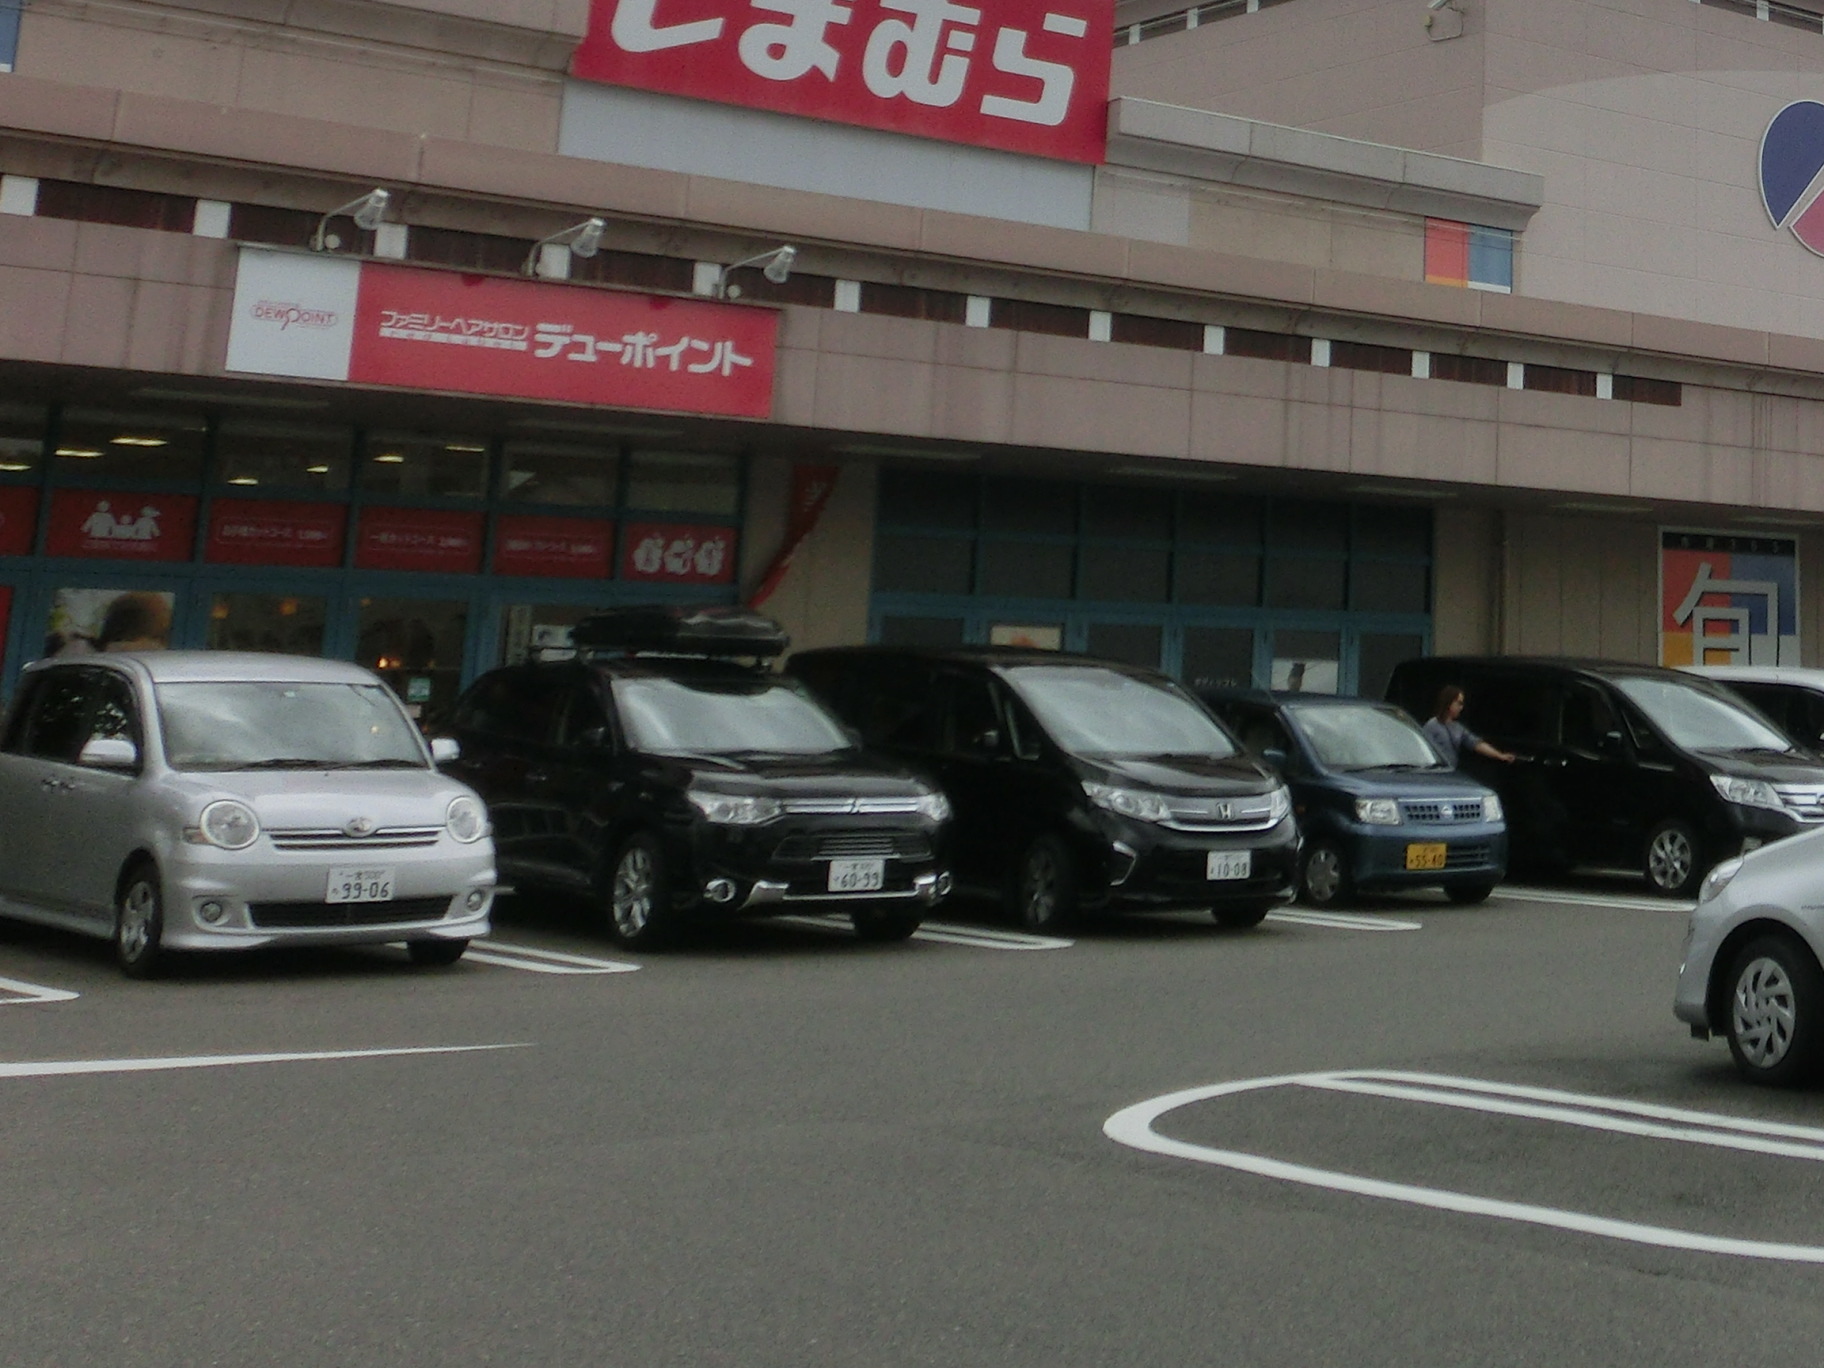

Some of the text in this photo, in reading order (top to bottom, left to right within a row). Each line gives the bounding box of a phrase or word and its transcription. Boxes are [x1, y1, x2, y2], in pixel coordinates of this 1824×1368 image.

[380, 310, 531, 340] ファミリーヘアサロン
[533, 322, 754, 376] デューポイント
[341, 881, 390, 899] 99-06
